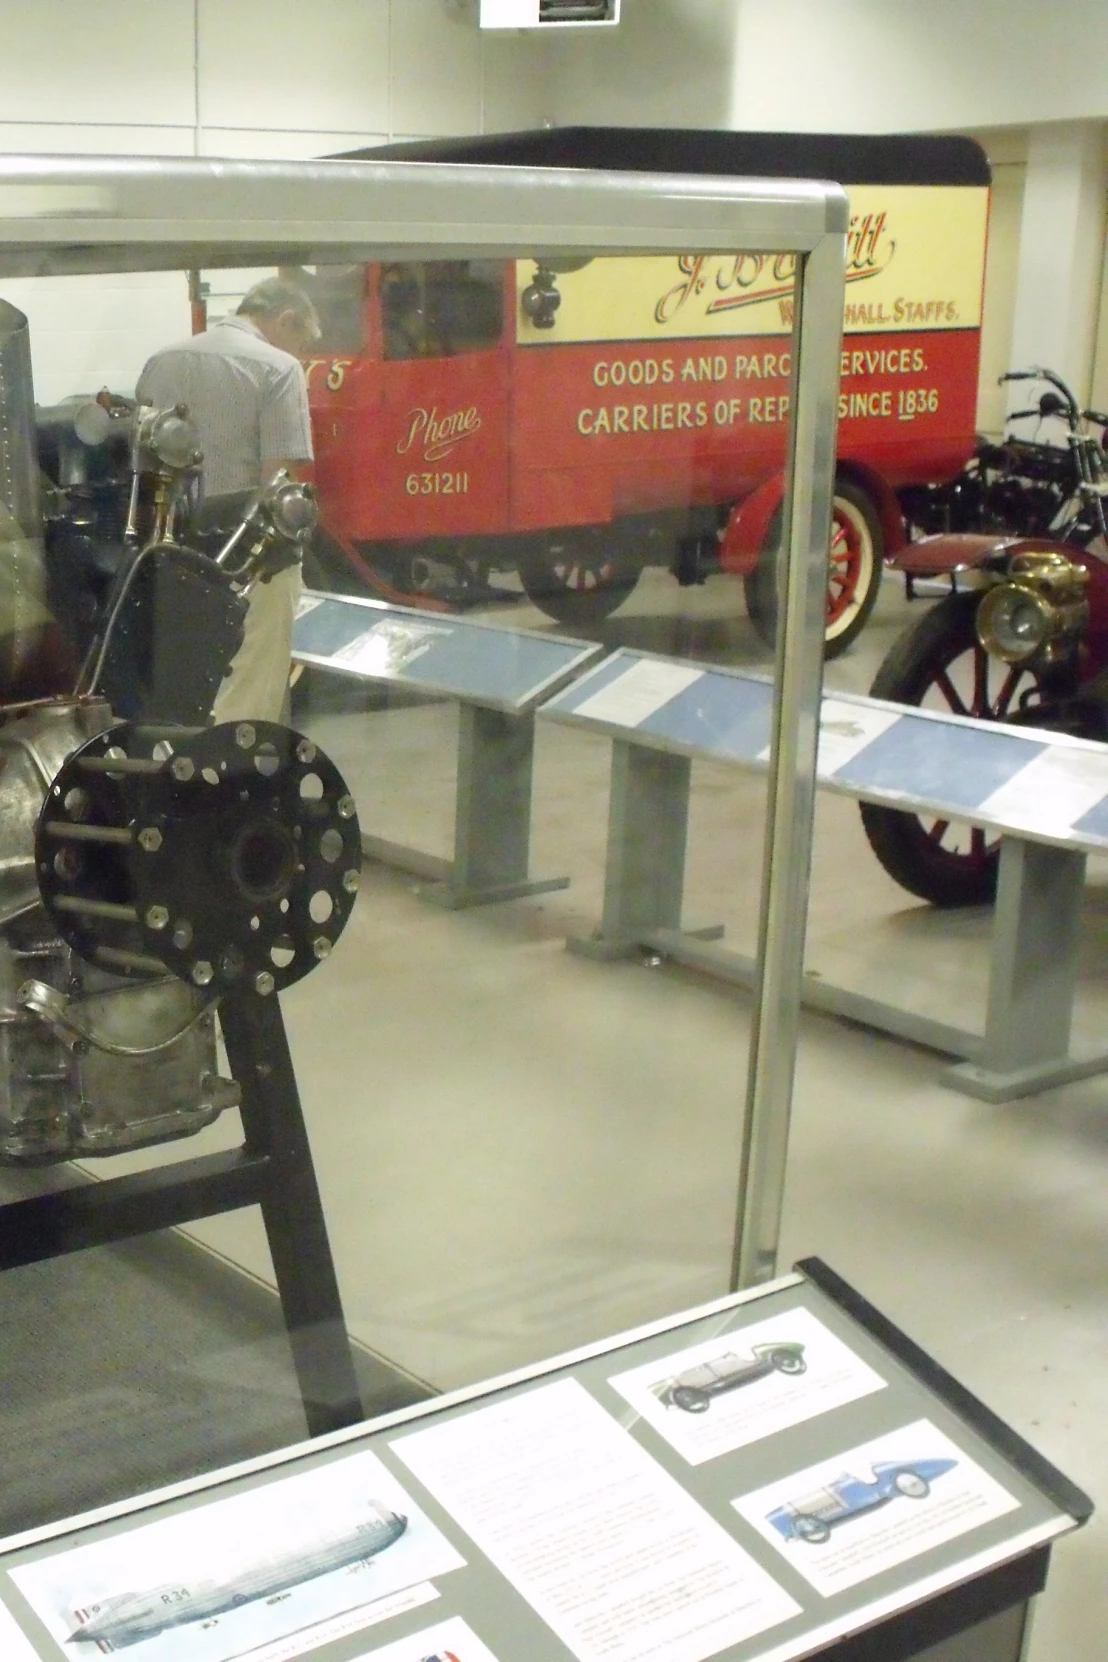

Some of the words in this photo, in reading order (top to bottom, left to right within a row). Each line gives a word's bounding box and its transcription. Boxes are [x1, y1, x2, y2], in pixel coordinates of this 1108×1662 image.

[593, 359, 675, 387] GOODS
[681, 355, 728, 382] AND
[840, 349, 929, 376] ERVICES.
[577, 401, 708, 435] CARRIERS
[714, 398, 741, 425] OF
[837, 391, 892, 418] SINCE
[899, 388, 939, 420] 1836
[397, 406, 481, 461] Phone
[406, 471, 469, 495] 631211
